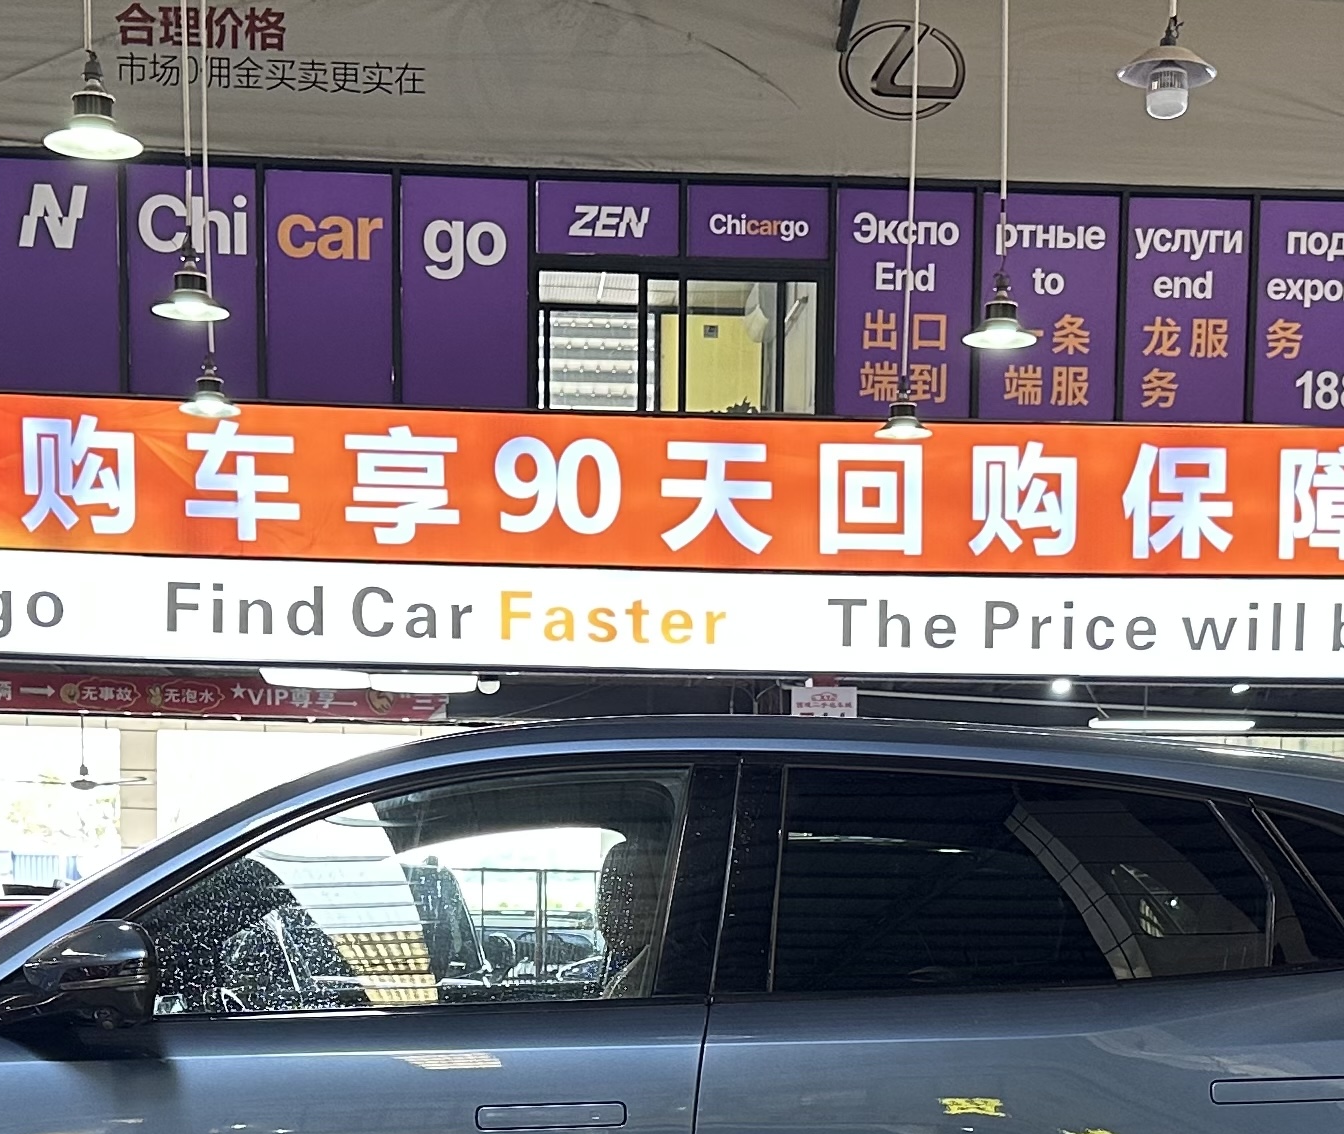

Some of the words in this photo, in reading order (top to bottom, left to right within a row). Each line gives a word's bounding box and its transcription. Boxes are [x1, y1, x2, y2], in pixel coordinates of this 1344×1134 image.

[116, 2, 286, 51] 合理价格
[138, 193, 247, 255] Chi
[277, 212, 383, 260] car
[424, 219, 506, 279] go
[569, 205, 649, 238] ZEN
[709, 213, 809, 241] Chicargo
[854, 211, 959, 246] Экспо
[996, 223, 1105, 255] ртные
[1135, 227, 1243, 260] услуги
[875, 262, 935, 292] End
[1032, 268, 1064, 295] to
[1153, 271, 1213, 299] end
[166, 581, 324, 637] Find
[352, 585, 473, 639] Car
[499, 591, 728, 645] Faster
[828, 598, 956, 650] The
[984, 601, 1157, 651] Price
[1183, 602, 1305, 653] will
[82, 686, 133, 703] 无事故
[164, 688, 215, 704] 无泡水
